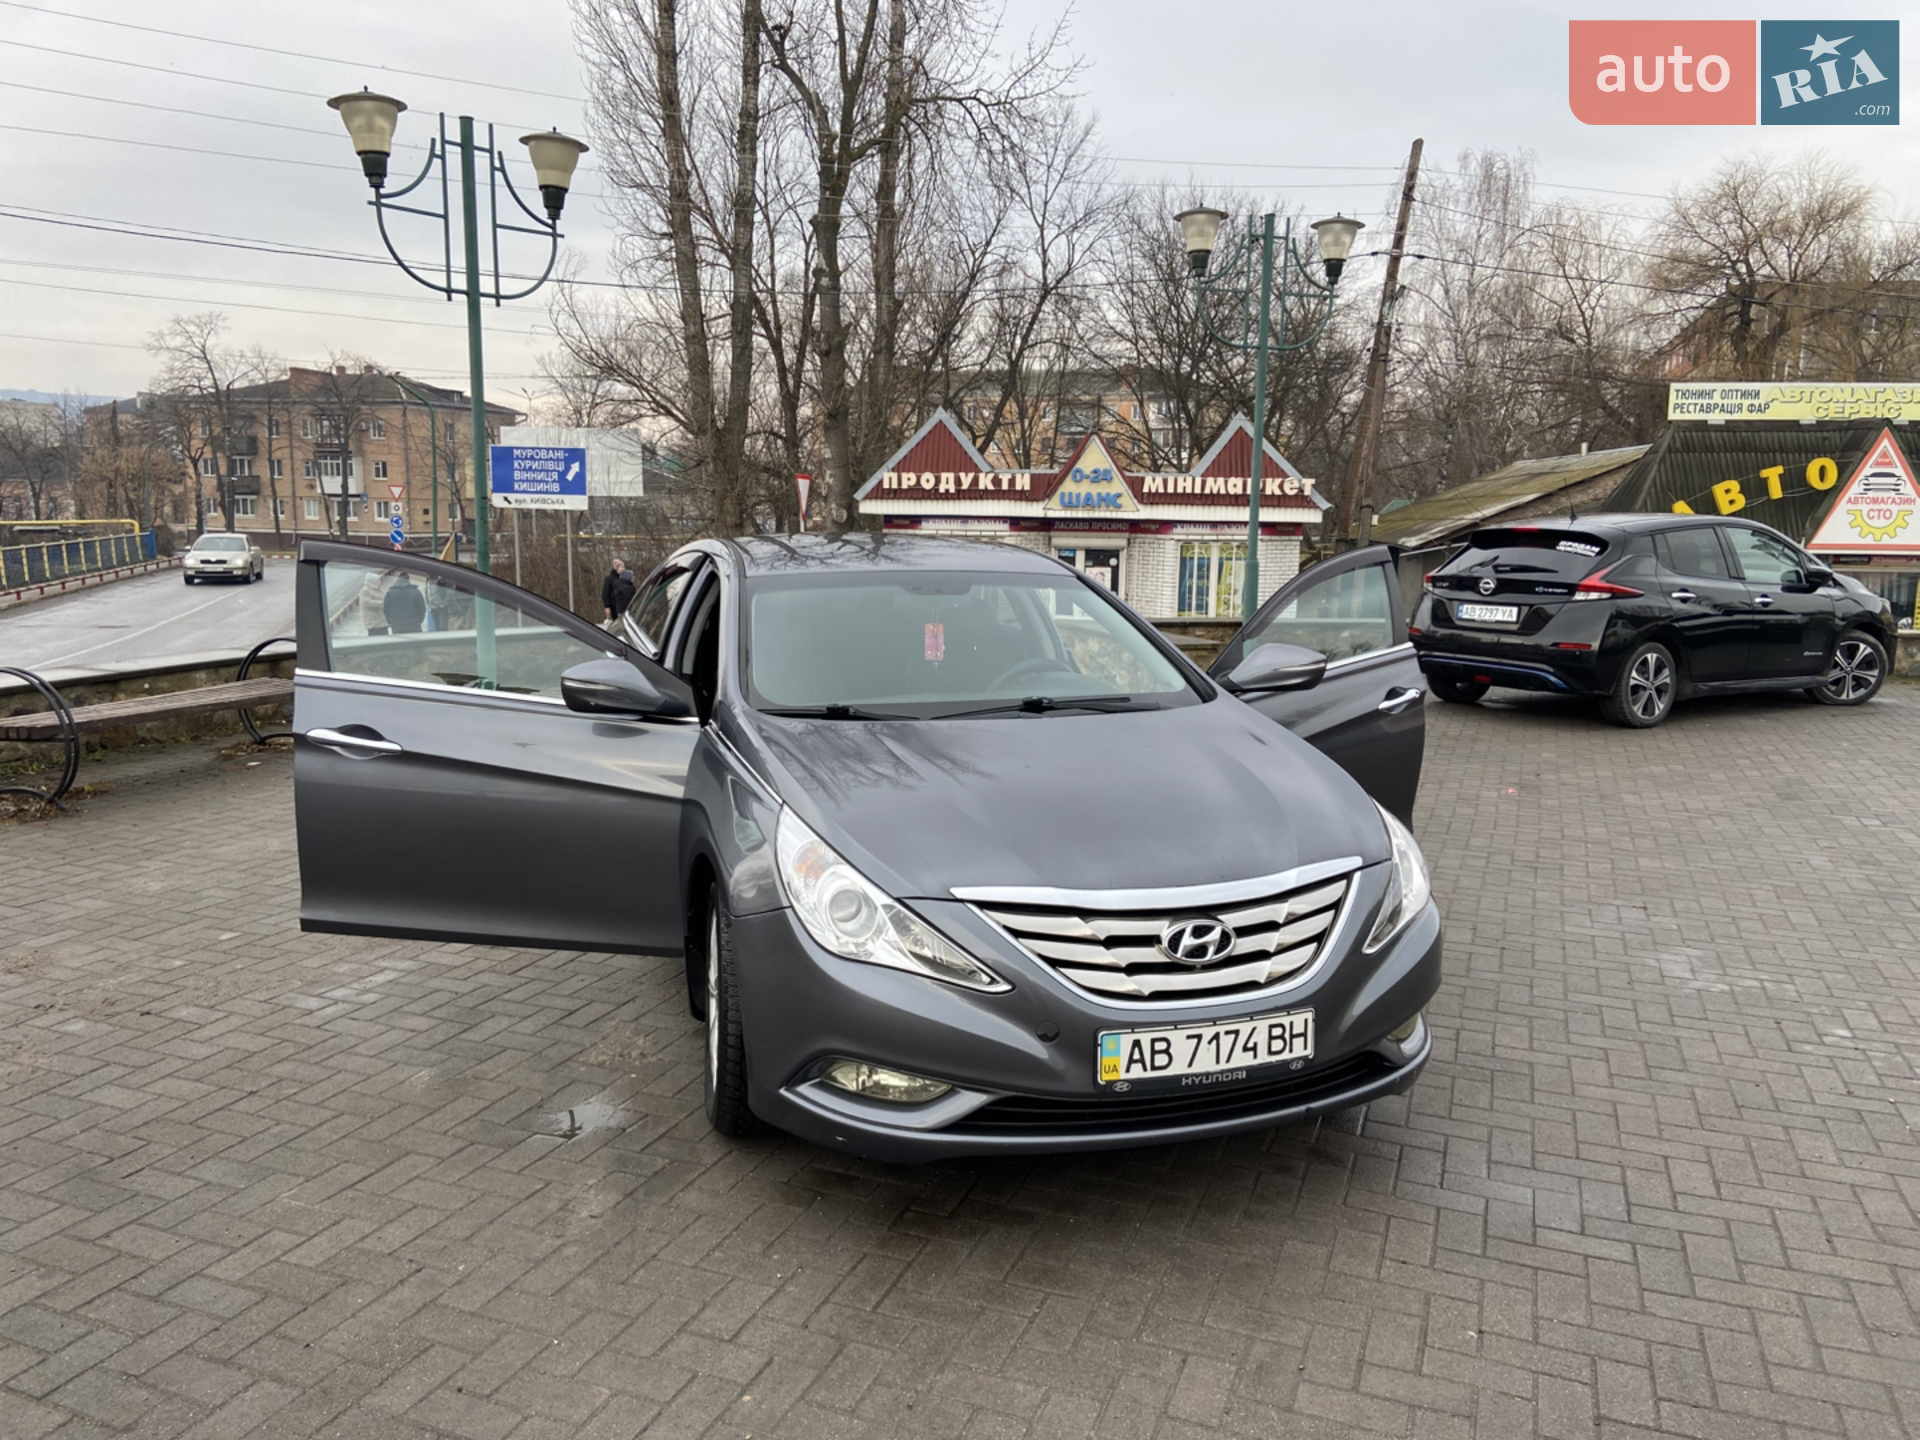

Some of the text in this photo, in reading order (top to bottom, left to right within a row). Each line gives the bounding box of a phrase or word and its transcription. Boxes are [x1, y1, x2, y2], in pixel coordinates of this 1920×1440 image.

[1674, 388, 1761, 400] ТЮНИНГ ОПТИКИ
[1672, 402, 1771, 416] РЕСТАВРАЦІЯ ФАР
[1811, 403, 1902, 419] СЕРВІС
[513, 449, 569, 460] МУРОВАНІ-
[513, 460, 565, 472] КУРИЛІВЦІ
[514, 470, 559, 482] ВІННИЦЯ
[882, 471, 1031, 493] ПРОДУКТИ
[514, 481, 560, 492] КИШИНІВ
[1059, 491, 1124, 508] ШАНС
[1846, 496, 1917, 506] АВТОМАГАЗИН
[1866, 508, 1894, 521] СТО
[1054, 521, 1089, 530] ЛАСКАВО
[1463, 606, 1477, 618] AB
[1478, 607, 1500, 619] 2797
[1125, 1018, 1309, 1074] AB 7174 BH
[1103, 1063, 1119, 1075] UA
[1182, 1070, 1247, 1087] HYUNDAI
